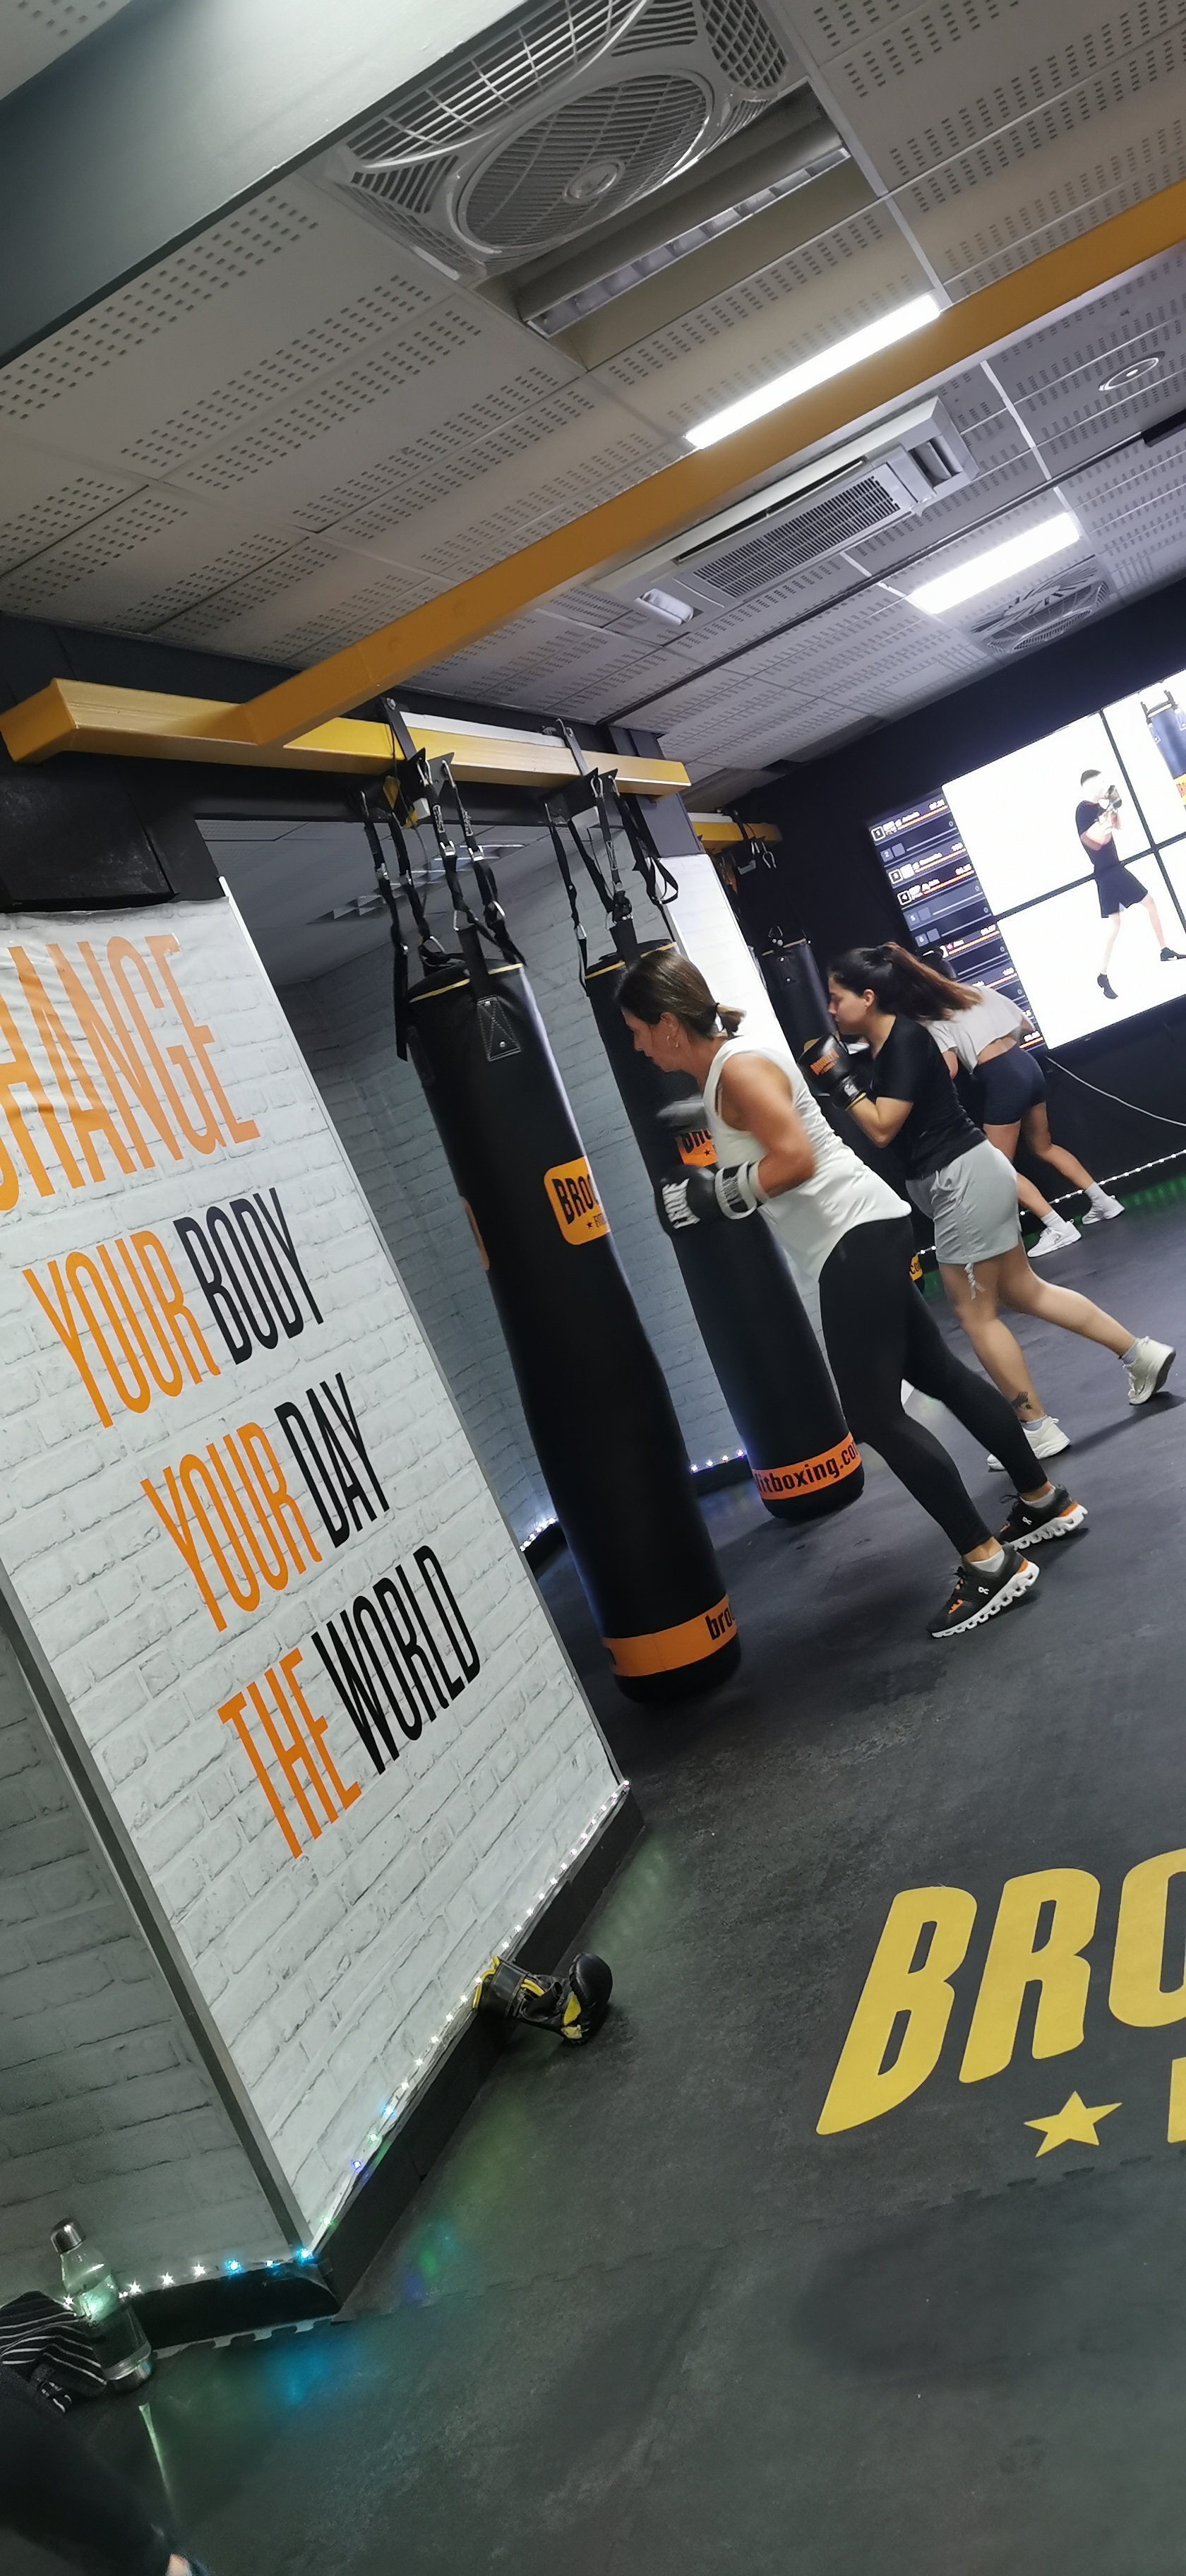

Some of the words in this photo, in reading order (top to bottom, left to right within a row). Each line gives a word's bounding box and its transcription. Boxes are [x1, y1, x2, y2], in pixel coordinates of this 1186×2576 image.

[0, 934, 260, 1211] HANGE
[22, 1229, 222, 1429] YOUR
[173, 1187, 324, 1366] BODY
[140, 1421, 323, 1633] YOUR
[273, 1372, 390, 1549] DAY
[217, 1647, 362, 1859] THE
[311, 1544, 481, 1776] WORLD
